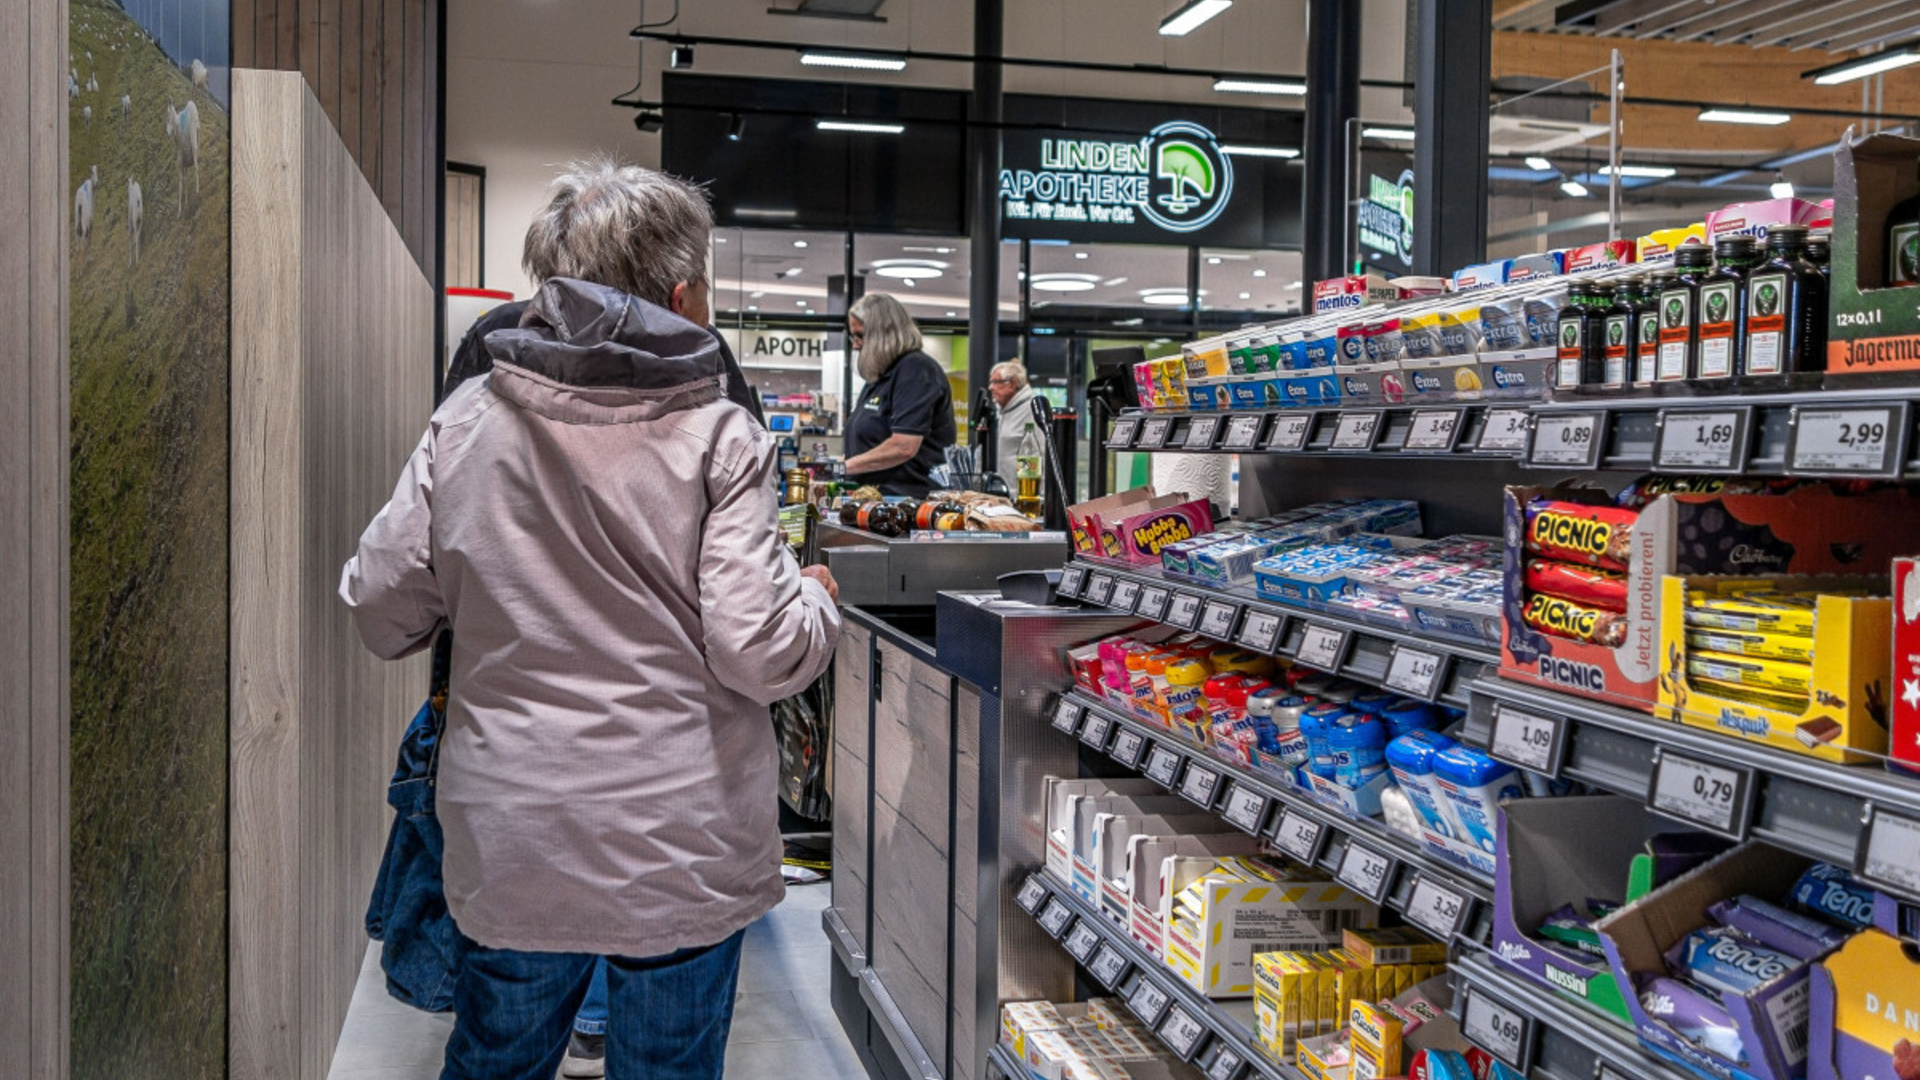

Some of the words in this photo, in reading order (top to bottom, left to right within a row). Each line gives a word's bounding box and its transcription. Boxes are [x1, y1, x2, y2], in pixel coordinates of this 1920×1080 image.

[1041, 139, 1150, 173] LINDEN
[999, 169, 1149, 204] APOTHEKE
[1316, 294, 1361, 311] mentos
[1415, 376, 1441, 388] extra
[1495, 369, 1526, 384] extra
[1430, 420, 1453, 434] 3,45
[1561, 427, 1591, 445] 0,89
[1696, 424, 1732, 446] 1,69
[1838, 423, 1884, 447] 2,99
[1134, 517, 1177, 547] Hubba
[1149, 523, 1191, 556] Bubba
[1535, 513, 1610, 554] PICNIC
[1729, 544, 1783, 566] Cadbury
[1638, 531, 1656, 622] probieren!
[1419, 611, 1447, 627] extra
[1526, 595, 1597, 636] PICNIC
[1319, 637, 1338, 652] 1,19
[1637, 627, 1652, 671] Jetzt
[1411, 661, 1435, 677] 1,19
[1539, 657, 1604, 691] PICNIC
[1719, 709, 1768, 737] Nesquik
[1521, 725, 1550, 748] 1,09
[1693, 775, 1732, 804] 0,79
[1296, 825, 1314, 844] 2,55
[1362, 859, 1384, 880] 2,55
[1432, 896, 1458, 919] 3,29
[1707, 936, 1785, 981] Tende
[1255, 963, 1280, 990] Ricola
[1545, 963, 1588, 997] Nussini
[1180, 1023, 1197, 1042] 0,95
[1352, 1008, 1380, 1041] Ricola
[1492, 1013, 1519, 1042] 0,69
